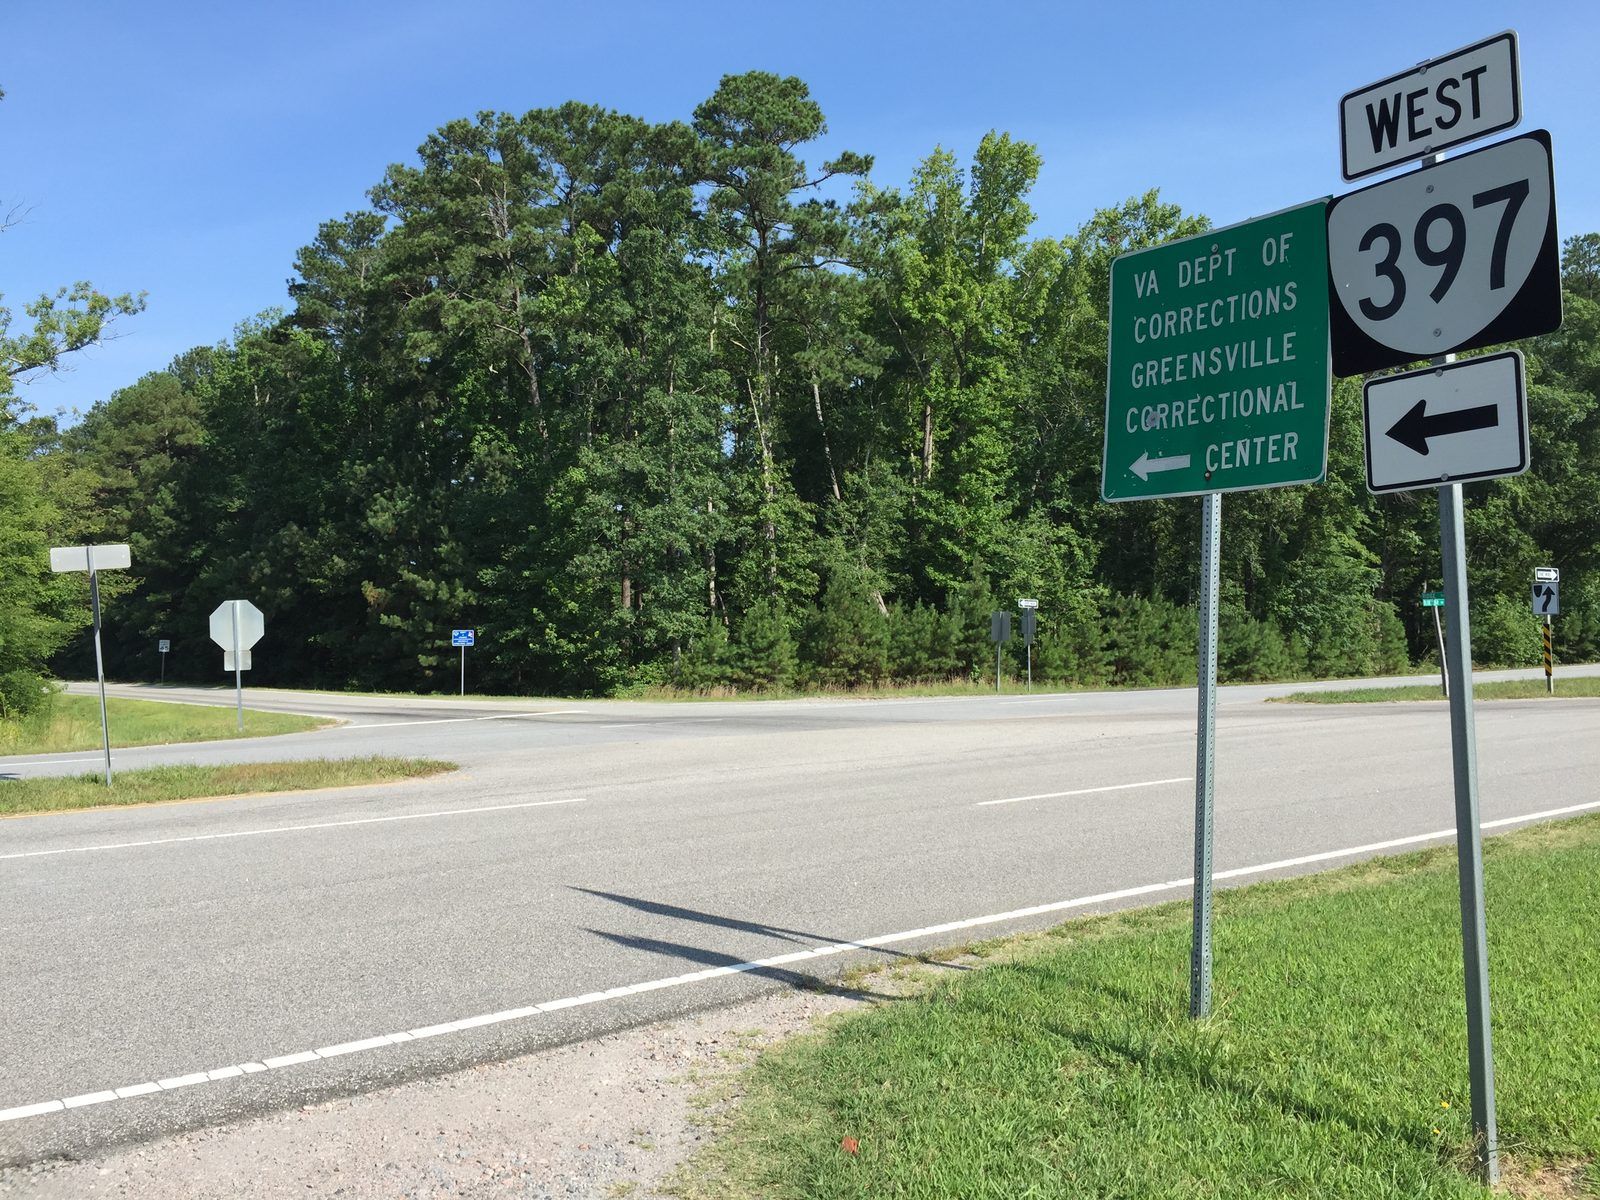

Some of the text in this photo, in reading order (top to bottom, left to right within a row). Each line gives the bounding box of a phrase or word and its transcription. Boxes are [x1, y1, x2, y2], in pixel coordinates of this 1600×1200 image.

[1365, 64, 1487, 154] WEST
[1134, 232, 1293, 298] VA DEPT OF
[1358, 178, 1530, 321] 397
[1134, 281, 1297, 343] CORRECTIONS
[1131, 332, 1296, 388] GREENSVILLE
[1126, 381, 1304, 433] CORRECTIONAL
[1205, 431, 1298, 471] CENTER
